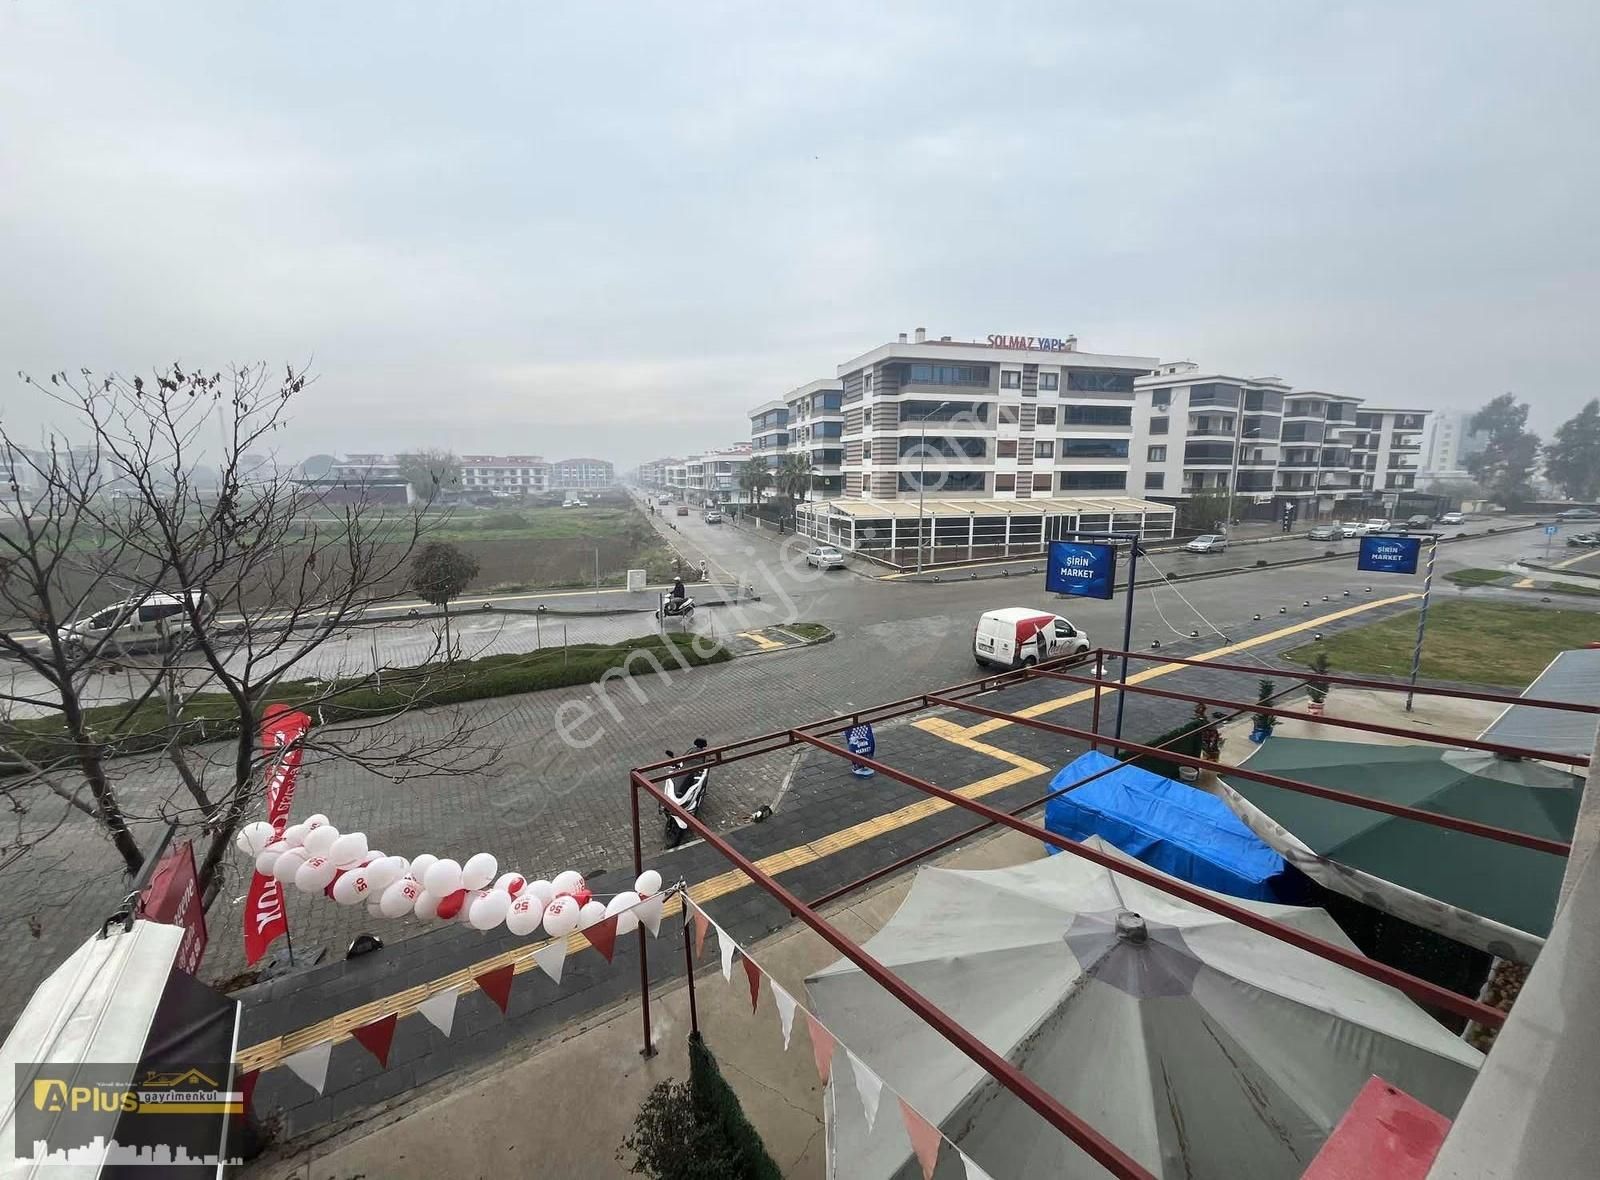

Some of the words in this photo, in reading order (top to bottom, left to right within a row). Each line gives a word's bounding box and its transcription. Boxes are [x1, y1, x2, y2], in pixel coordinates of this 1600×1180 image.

[987, 334, 1034, 350] SOLMAZ
[1066, 556, 1089, 566] ŞİRİN
[1060, 567, 1094, 578] MARKET
[356, 877, 368, 892] 50
[403, 886, 416, 899] 50
[514, 901, 529, 911] 50
[549, 904, 562, 915] 50
